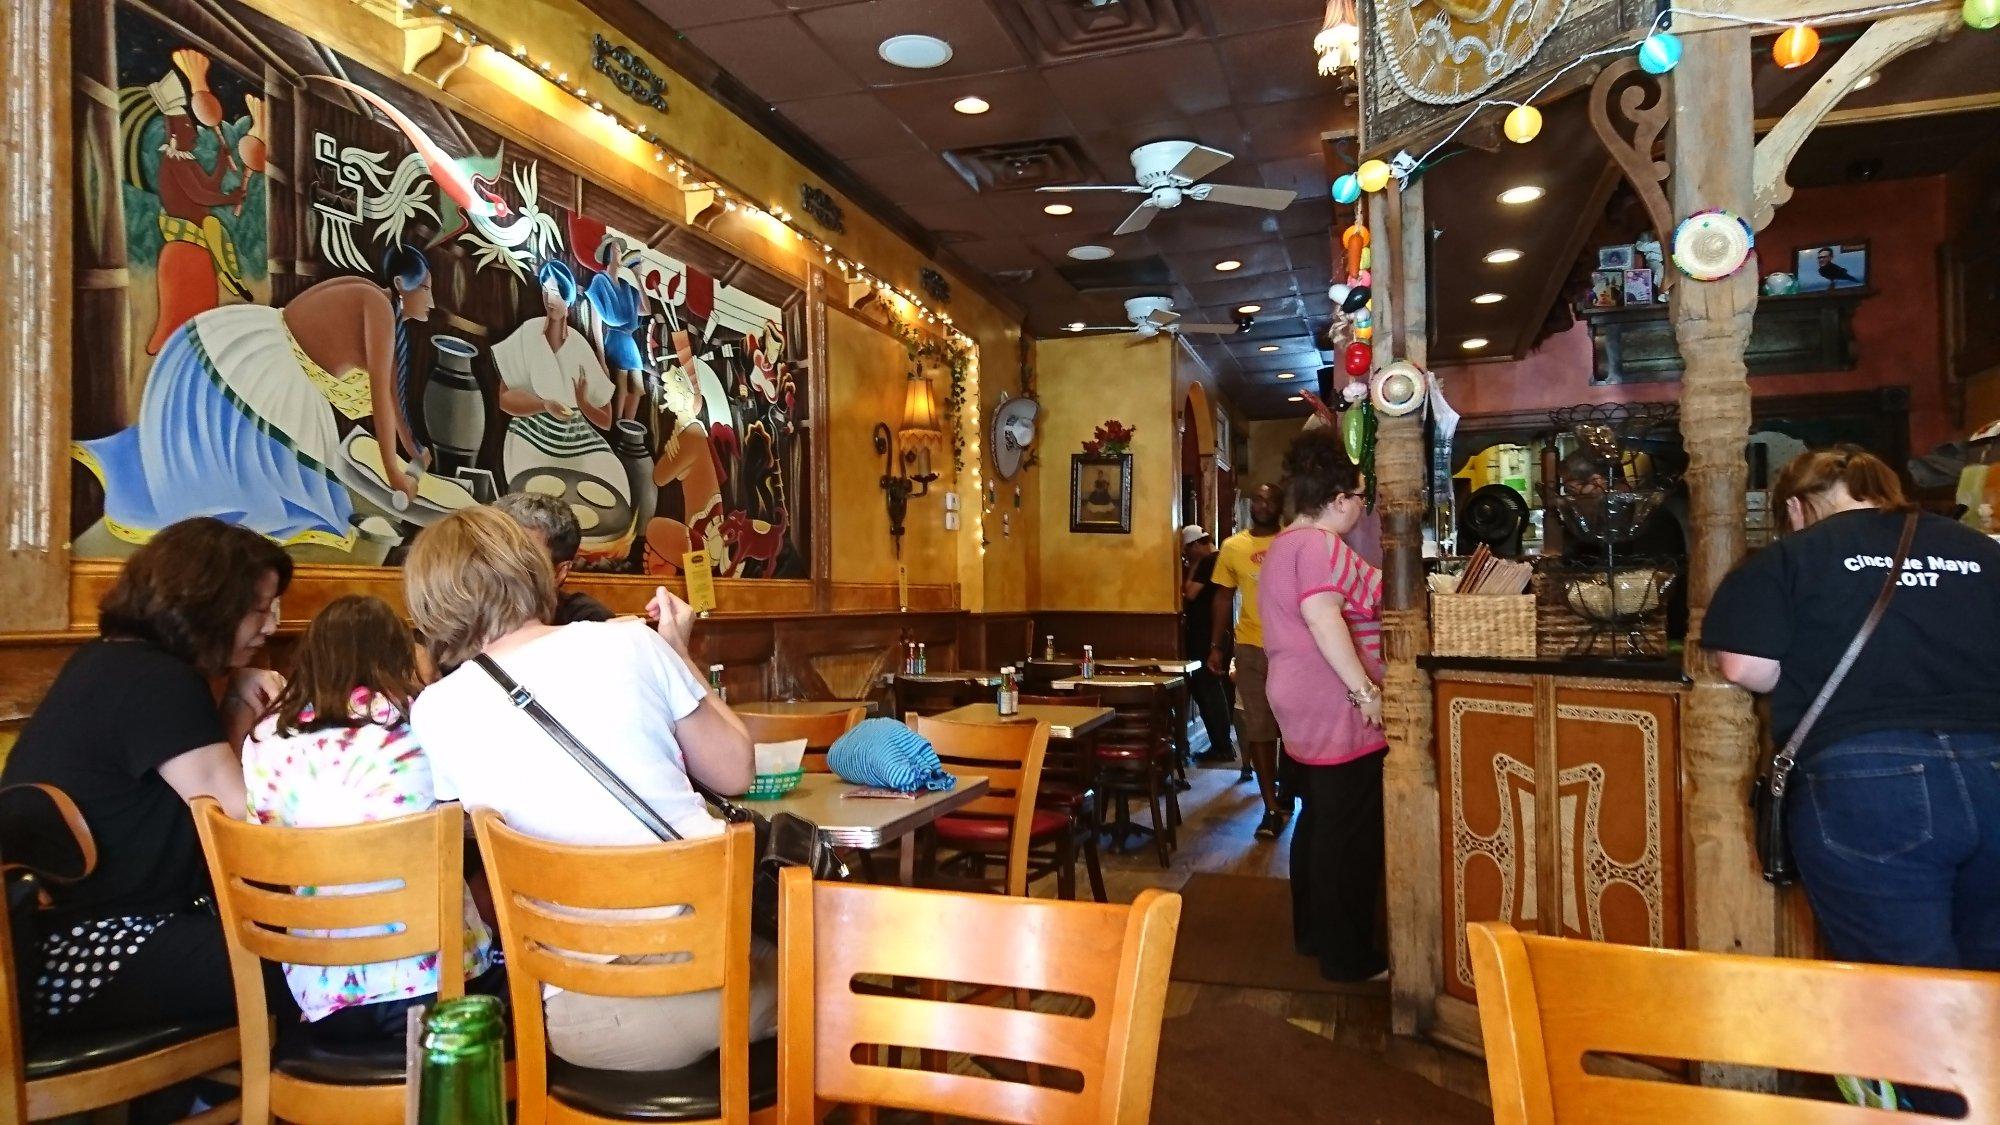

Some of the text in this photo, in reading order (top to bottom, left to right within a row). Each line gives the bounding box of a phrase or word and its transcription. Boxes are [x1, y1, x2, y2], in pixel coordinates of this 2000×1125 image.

[1843, 554, 1894, 571] Cinco
[1926, 555, 1981, 575] Mayo
[1887, 571, 1940, 587] 017
